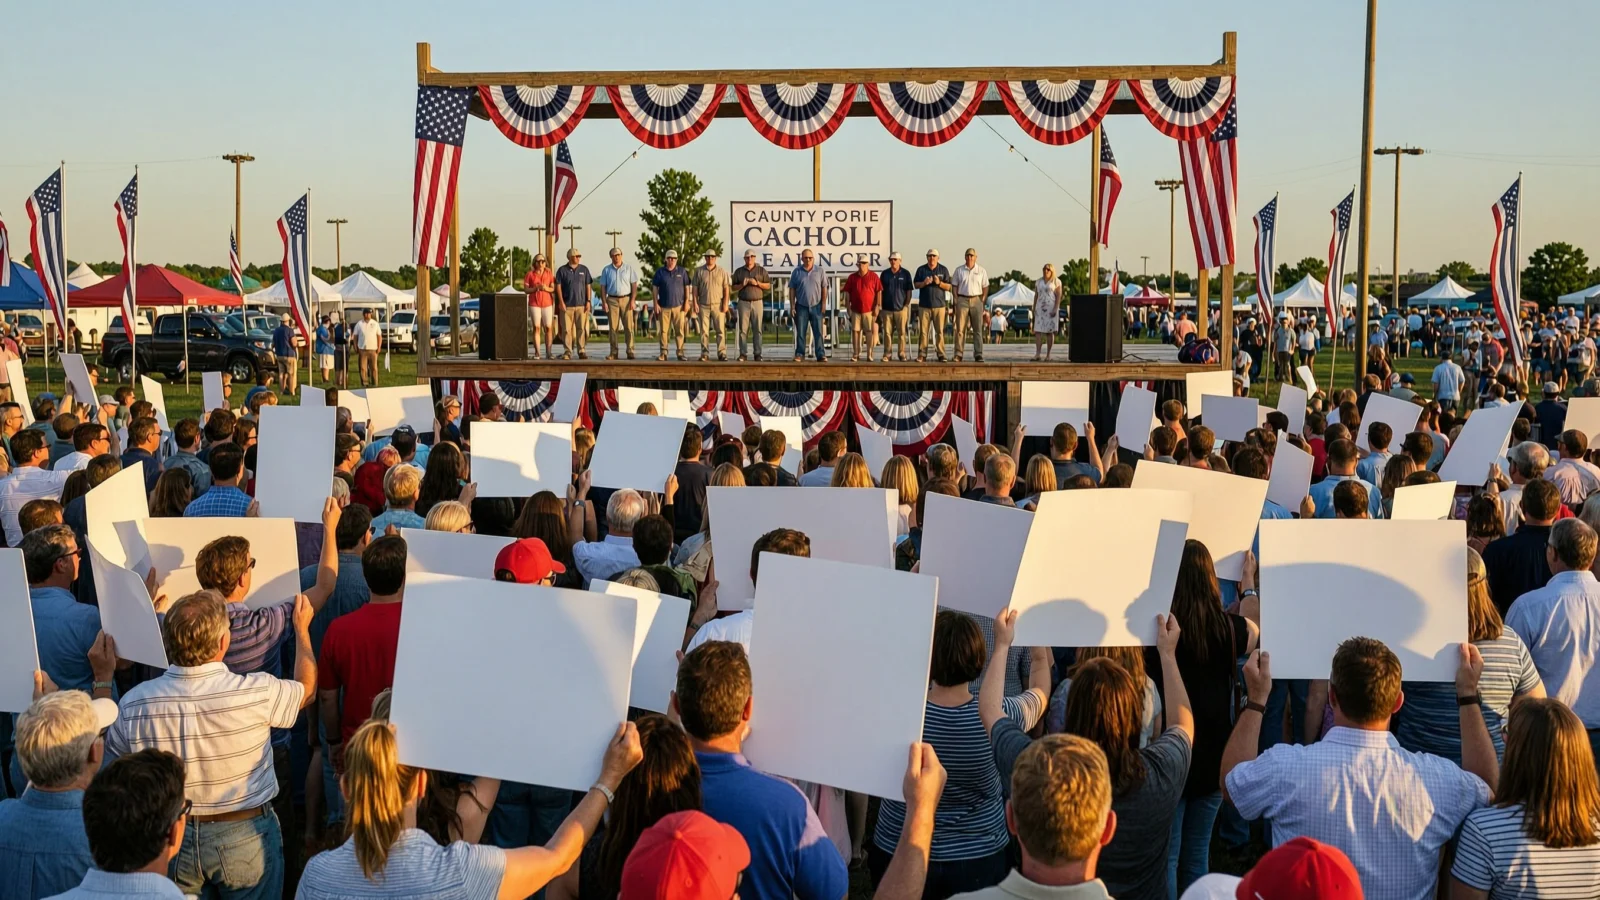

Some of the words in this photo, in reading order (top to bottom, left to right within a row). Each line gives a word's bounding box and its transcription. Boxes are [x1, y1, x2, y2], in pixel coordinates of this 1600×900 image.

[744, 210, 817, 223] CAUNTY
[823, 210, 879, 222] PORIE
[743, 226, 880, 247] CACHOLL
